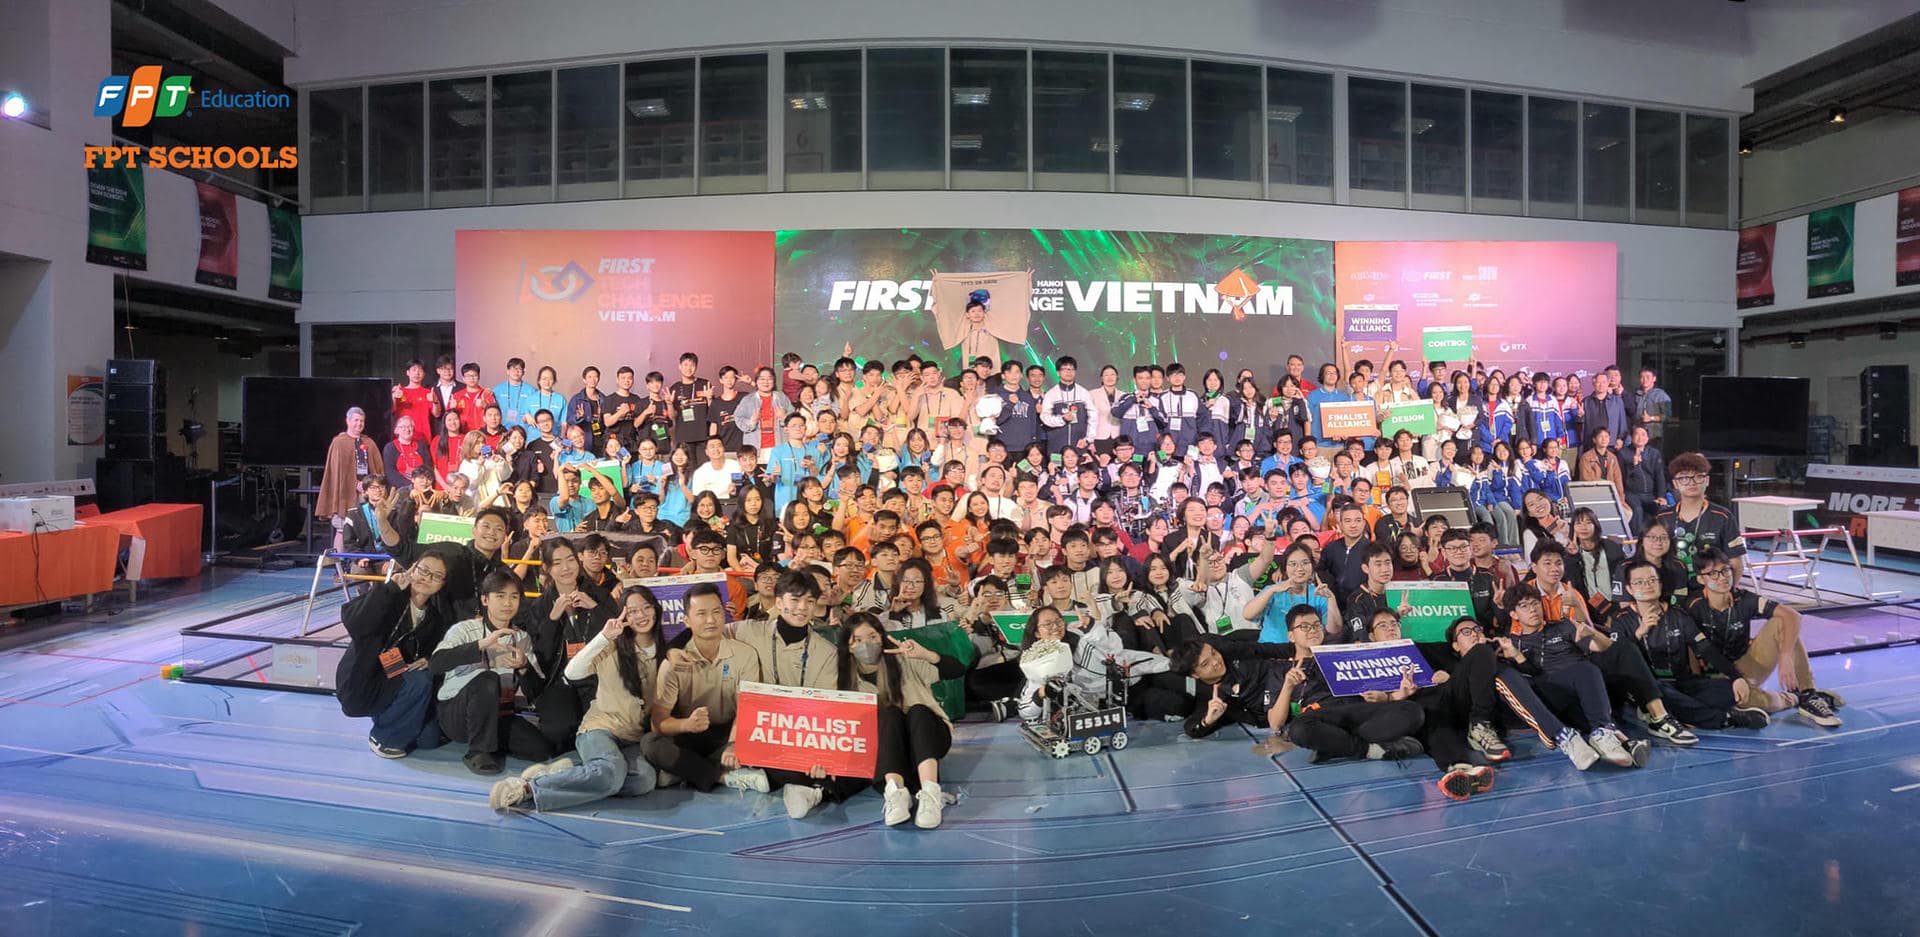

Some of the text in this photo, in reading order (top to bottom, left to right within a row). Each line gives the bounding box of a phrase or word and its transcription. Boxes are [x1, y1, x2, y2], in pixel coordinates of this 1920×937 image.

[598, 258, 656, 273] FIRST
[1036, 280, 1064, 288] HANOI
[828, 280, 933, 311] FIRST
[1064, 281, 1293, 315] VIETNAM
[1348, 324, 1393, 332] ALLIANCE
[1351, 317, 1391, 325] WINNING
[1427, 339, 1468, 348] CONTROL
[1511, 343, 1528, 351] RTX
[1328, 412, 1369, 420] FINALIST
[1391, 413, 1425, 424] DESIGN
[1327, 420, 1371, 428] ALLIANCE
[1828, 492, 1906, 514] MORE
[1333, 655, 1411, 671] WINNING
[1336, 663, 1424, 682] ALLIANCE
[756, 711, 861, 735] FINALIST
[1075, 713, 1121, 731] 25314
[749, 727, 867, 754] ALLIANCE
